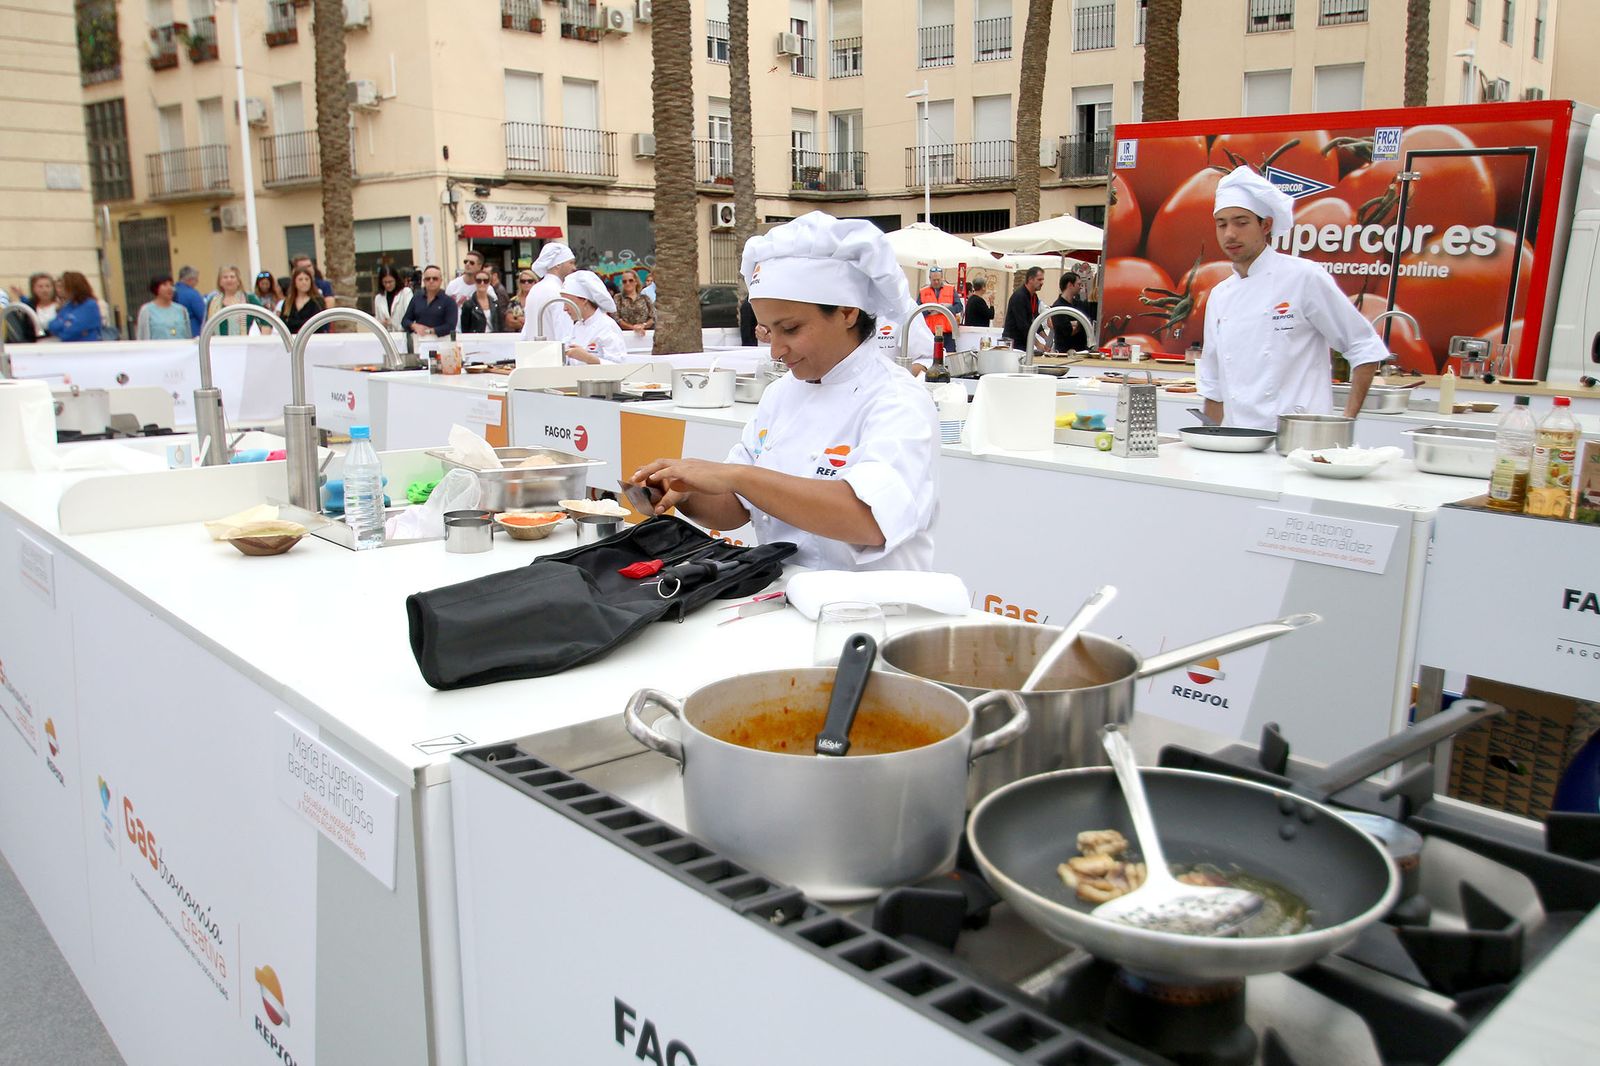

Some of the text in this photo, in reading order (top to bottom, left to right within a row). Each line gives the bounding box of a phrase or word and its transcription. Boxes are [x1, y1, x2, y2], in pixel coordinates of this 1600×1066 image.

[1376, 130, 1399, 145] FRCX
[493, 226, 537, 238] REGALOS
[1271, 223, 1497, 257] ipercor.es
[1397, 260, 1450, 279] online
[544, 425, 571, 440] FAGOR
[1266, 527, 1308, 544] Puente
[1171, 684, 1230, 710] REPSOL
[321, 753, 365, 801] Eugenia
[328, 781, 374, 835] Hinojosa
[181, 910, 227, 979] creativa
